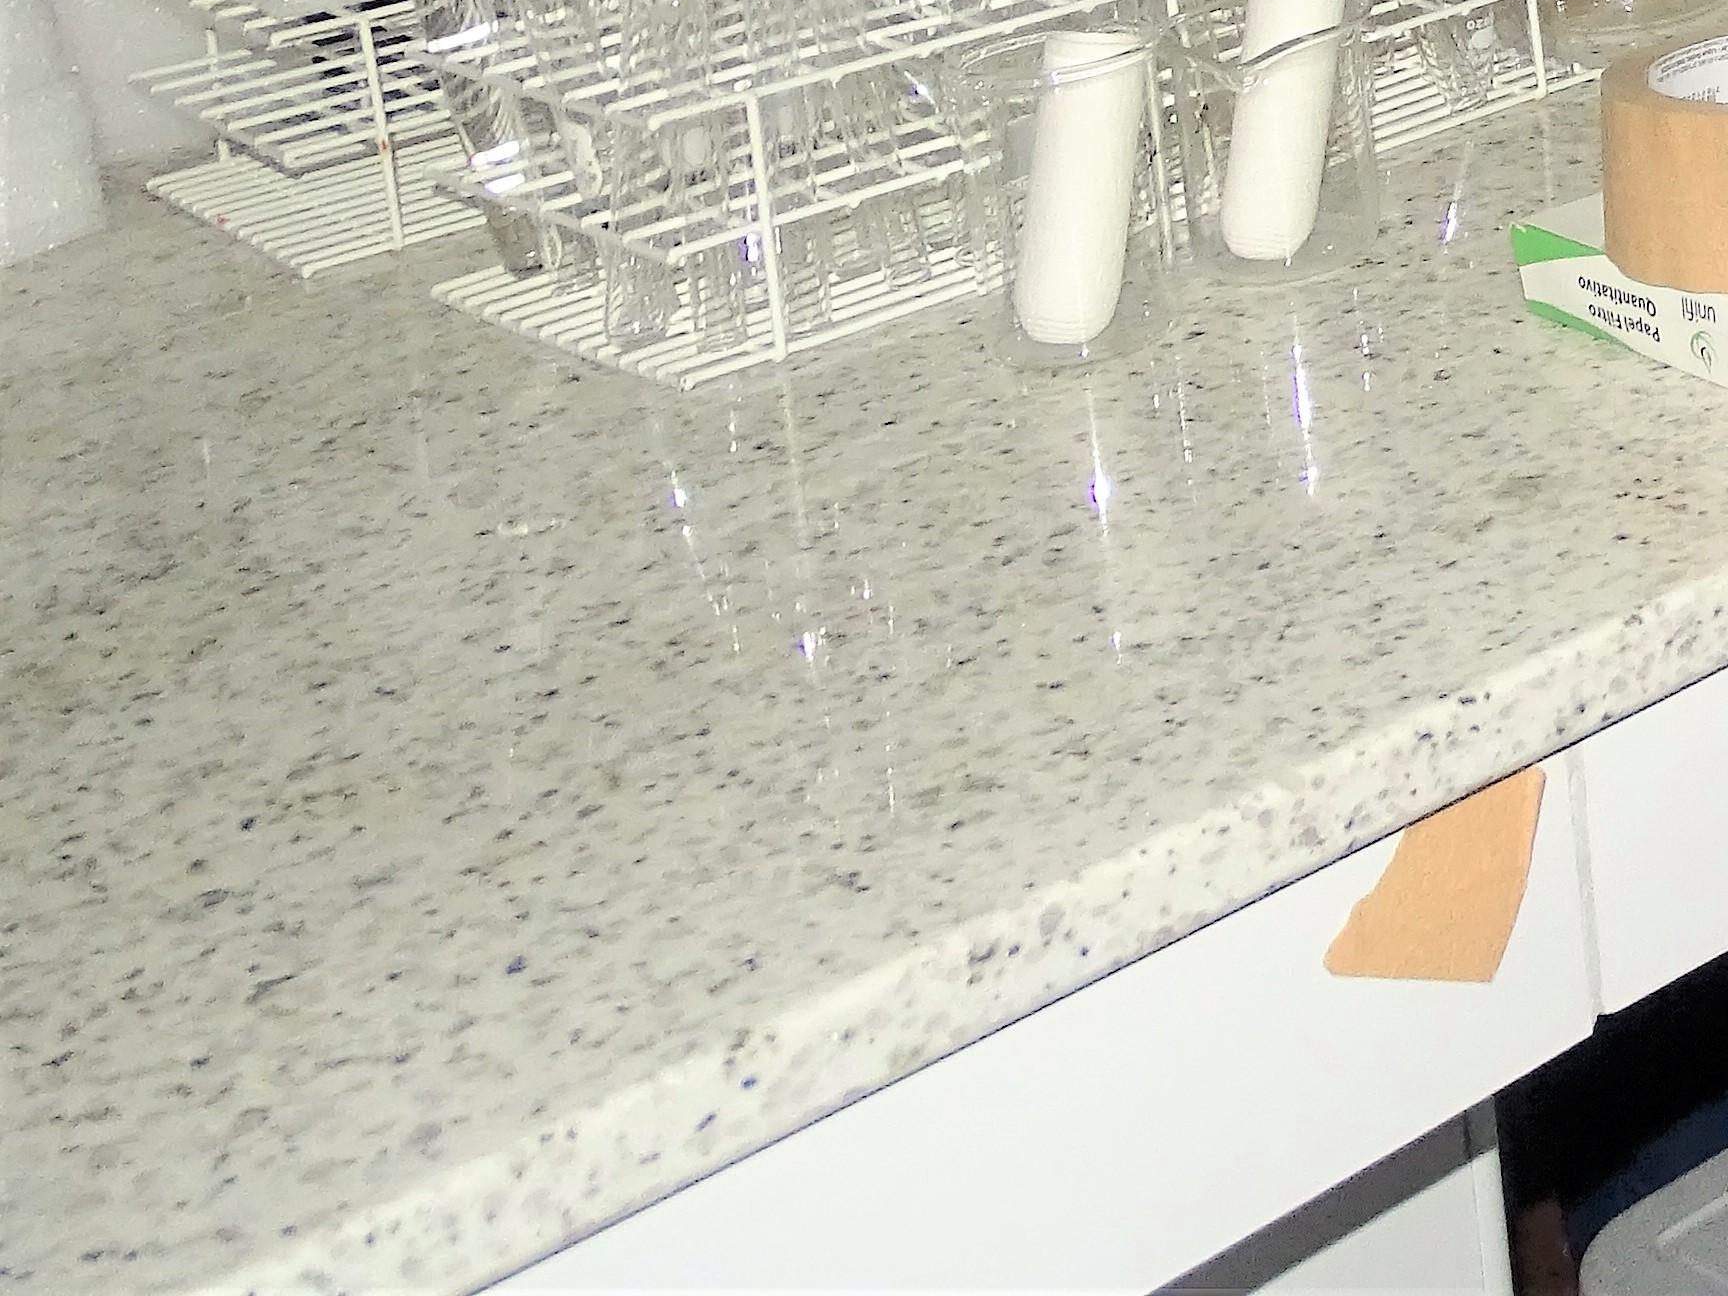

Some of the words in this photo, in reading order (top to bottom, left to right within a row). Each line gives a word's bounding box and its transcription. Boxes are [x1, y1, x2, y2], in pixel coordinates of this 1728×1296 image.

[1577, 275, 1657, 318] Quantitativo
[1680, 295, 1717, 324] unifil
[1588, 303, 1623, 330] Filtro
[1625, 315, 1661, 343] Papel
